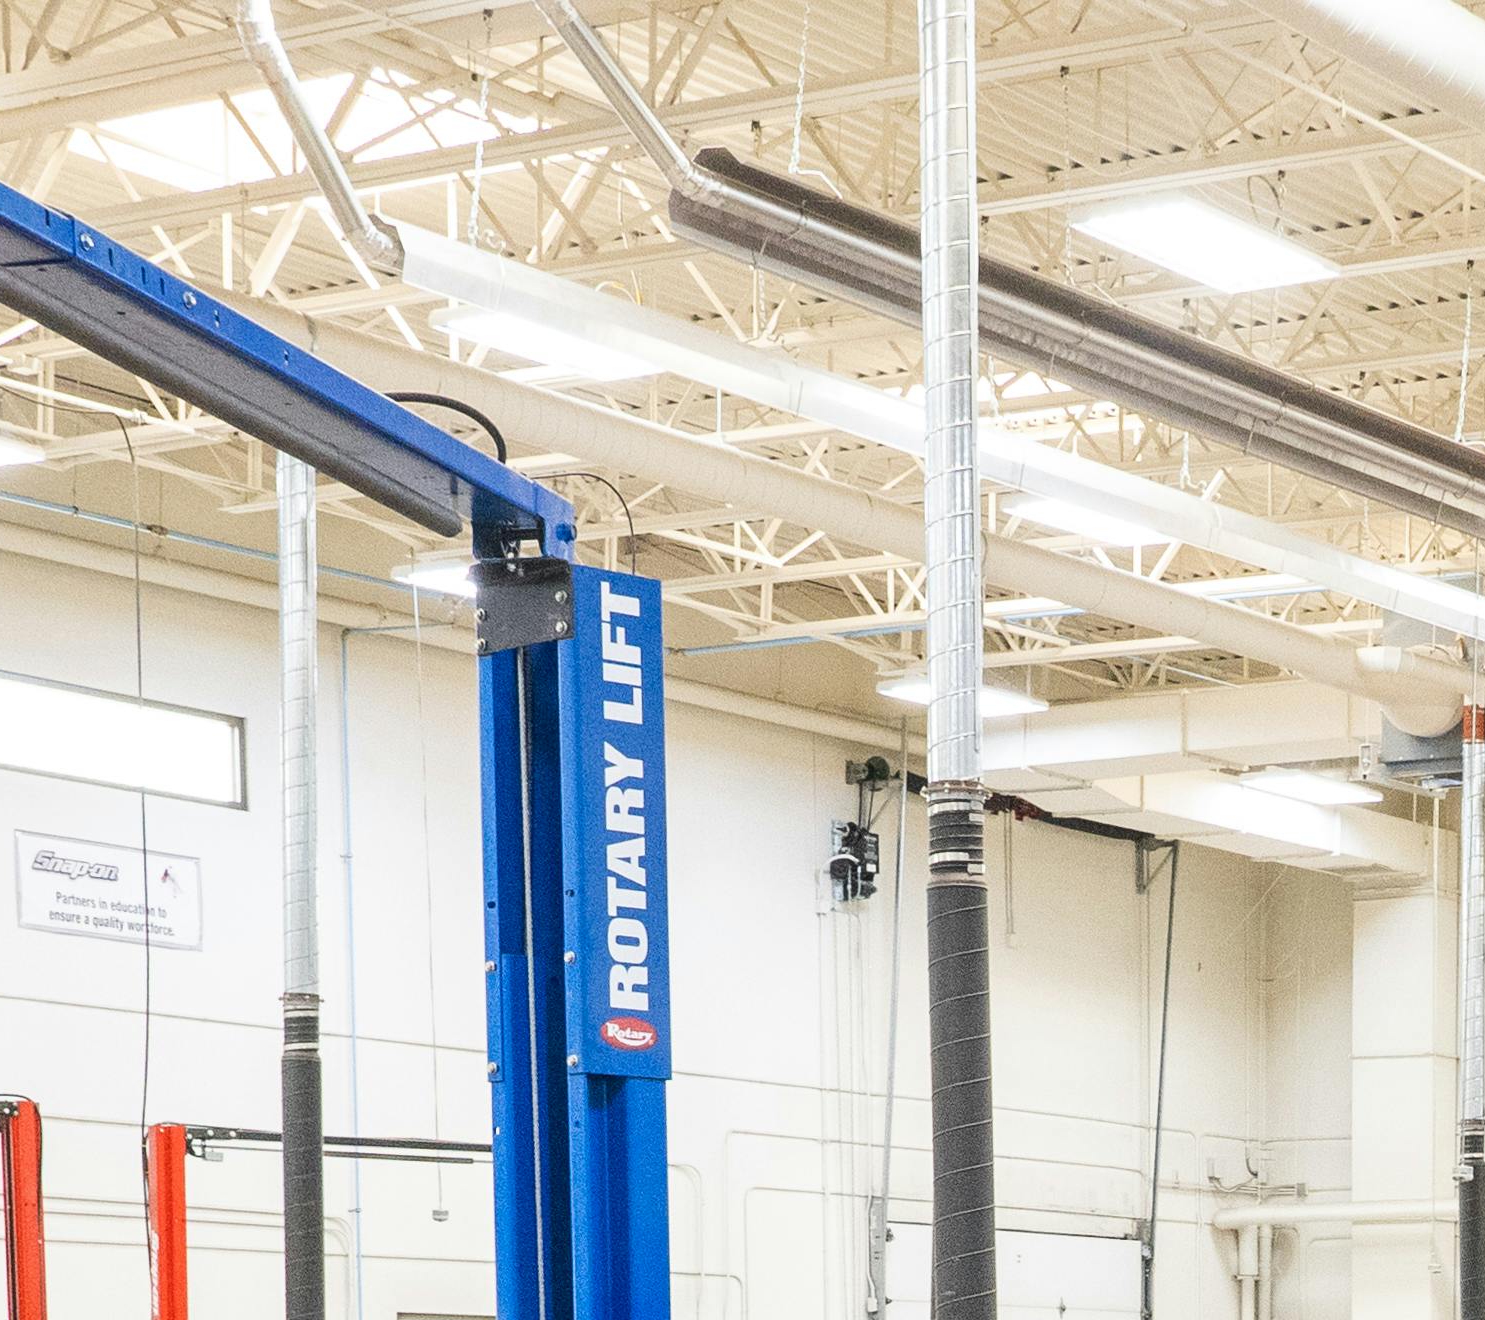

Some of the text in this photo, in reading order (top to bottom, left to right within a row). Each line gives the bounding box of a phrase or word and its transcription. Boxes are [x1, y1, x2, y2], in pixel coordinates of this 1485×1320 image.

[600, 581, 649, 1012] ROTARY LIFT
[32, 850, 119, 881] Snap-on
[56, 891, 97, 909] Partners
[99, 897, 108, 909] in
[158, 907, 167, 918] to
[49, 911, 81, 924] ensure
[84, 915, 90, 924] a
[93, 916, 124, 931] quality
[605, 1020, 655, 1046] Rotary
